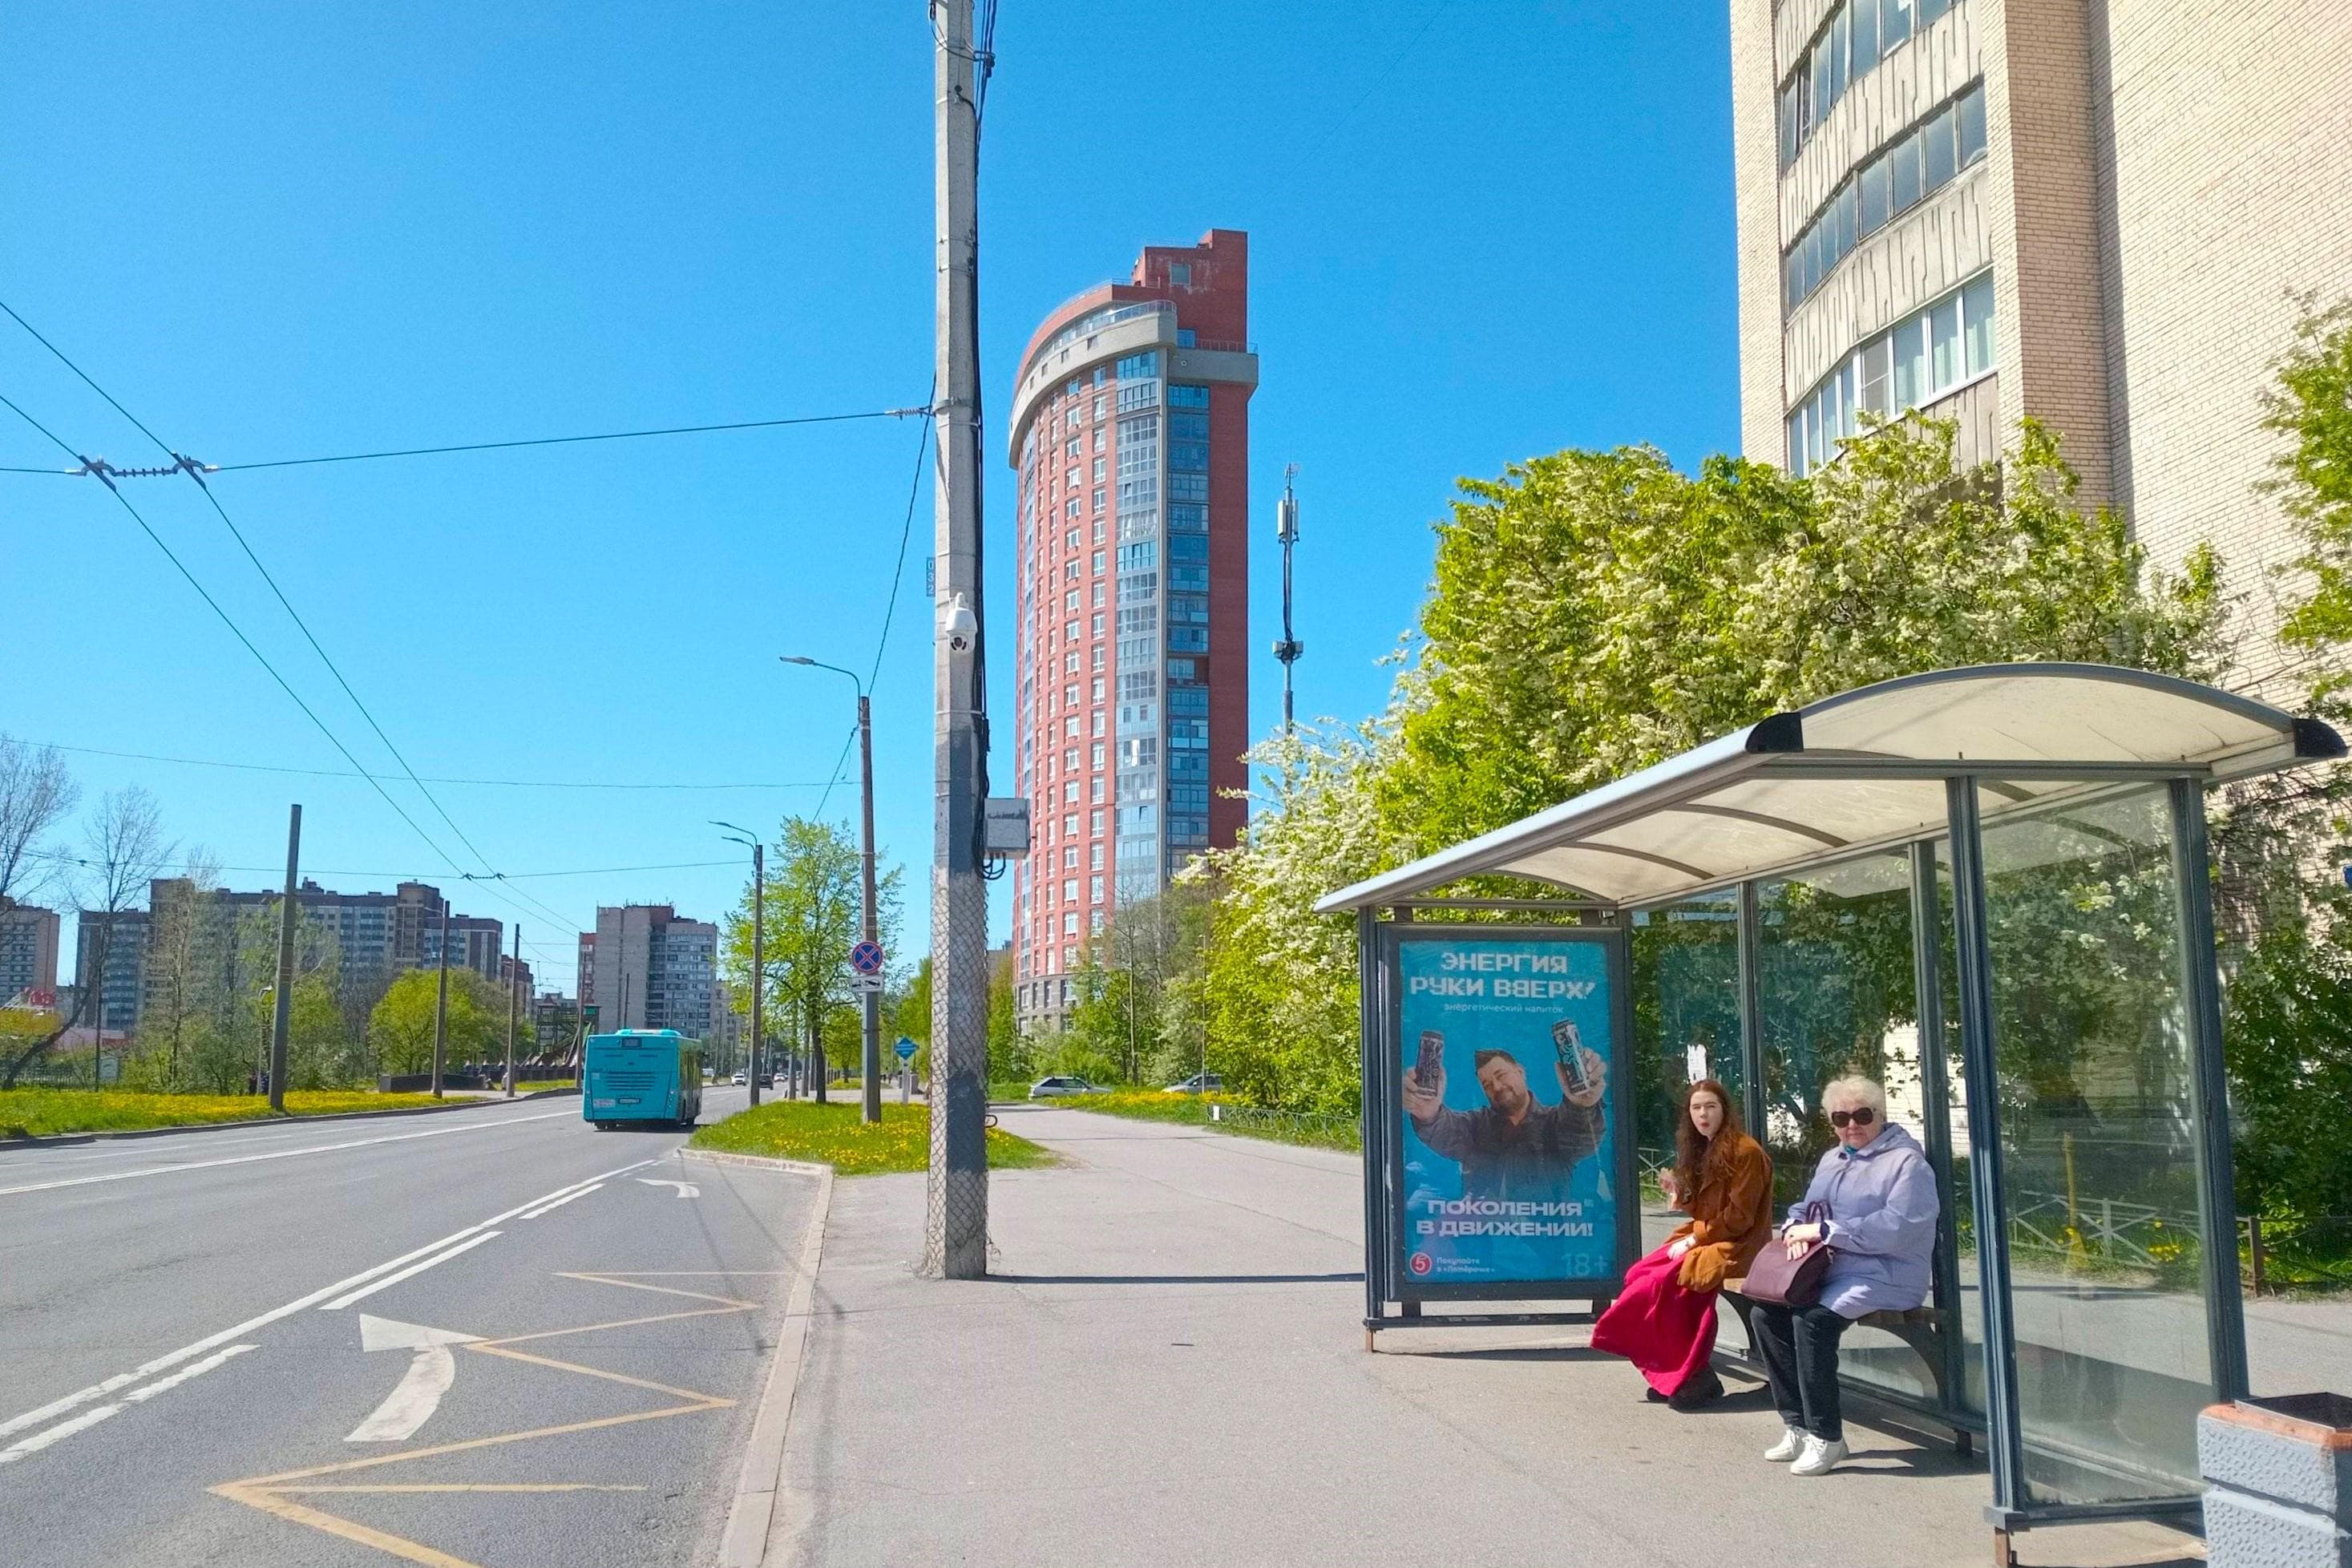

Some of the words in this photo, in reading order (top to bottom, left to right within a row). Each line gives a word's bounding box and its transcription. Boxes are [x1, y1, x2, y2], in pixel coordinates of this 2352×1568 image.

[1441, 952, 1567, 973] ЭНЕРГИЯ
[1410, 976, 1484, 996] РУКИ
[1444, 1003, 1522, 1012] энергетический
[1525, 1005, 1563, 1013] напиток
[1428, 1200, 1582, 1216] ПОКОЛЕНИЯ
[1416, 1220, 1434, 1235] В
[1439, 1220, 1593, 1237] ДВИЖЕНИИ!
[1415, 1255, 1427, 1271] 5
